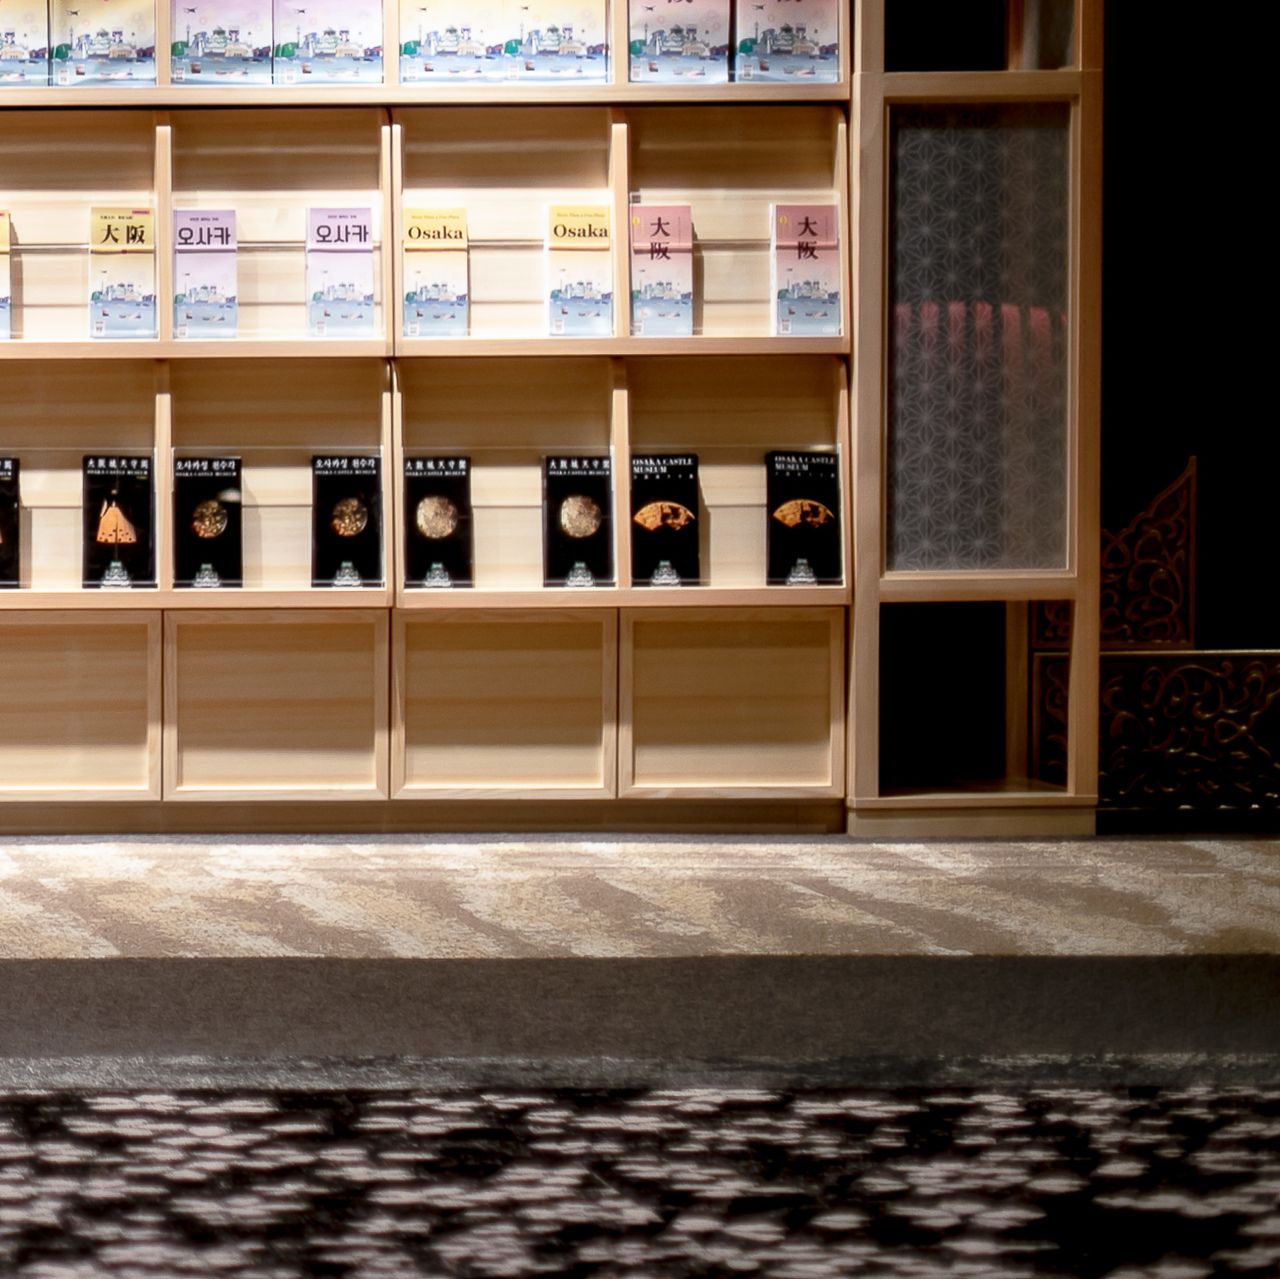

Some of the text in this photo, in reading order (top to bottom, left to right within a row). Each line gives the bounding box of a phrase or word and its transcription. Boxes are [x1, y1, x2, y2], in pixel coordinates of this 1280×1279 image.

[101, 224, 146, 244] 大阪
[178, 226, 231, 246] 오사카
[316, 224, 370, 244] 오사카
[408, 225, 464, 240] Osaka
[553, 223, 609, 239] Osaka
[650, 216, 672, 261] 大阪
[798, 216, 819, 260] 大阪
[632, 457, 693, 466] OSAKA CASTLE
[775, 462, 809, 470] MUSEUM
[805, 456, 836, 464] CASTLE
[632, 466, 667, 474] MUSEUM
